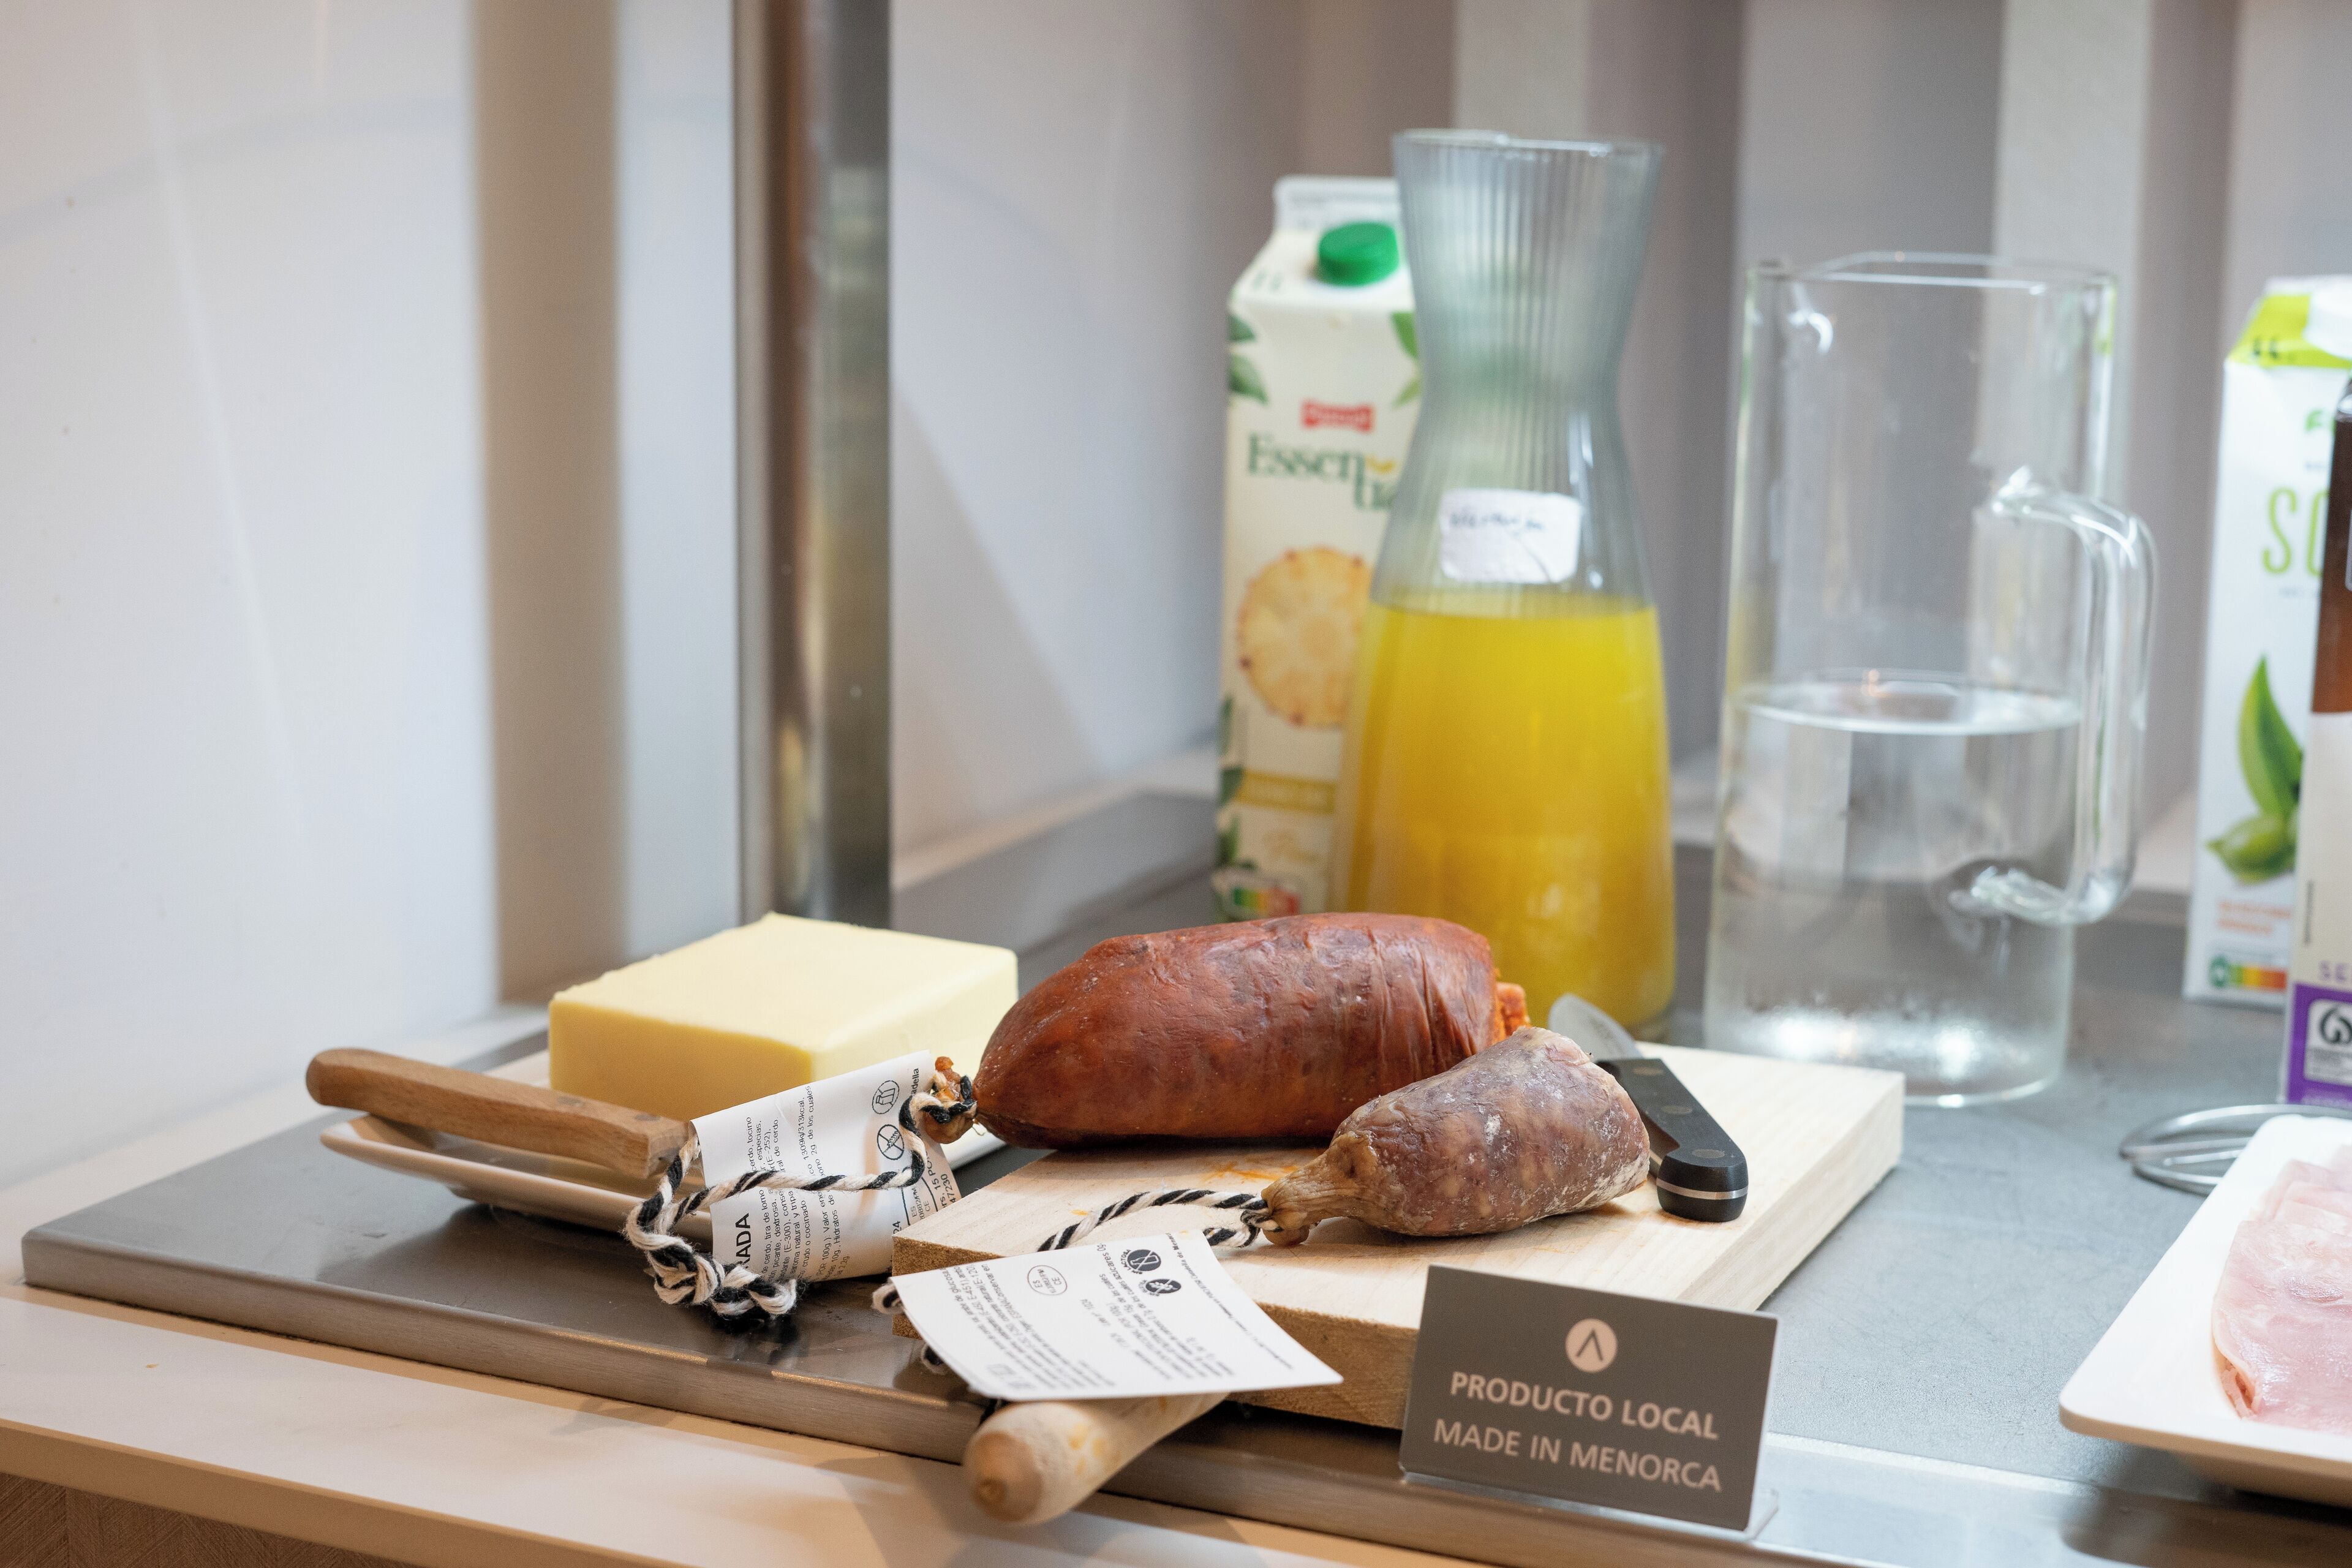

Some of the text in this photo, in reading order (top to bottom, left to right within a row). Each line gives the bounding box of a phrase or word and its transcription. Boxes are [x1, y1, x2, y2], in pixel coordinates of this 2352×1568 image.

[805, 1085, 813, 1112] cuales
[807, 1129, 813, 1139] de
[774, 1145, 780, 1156] de
[931, 1177, 940, 1190] 15
[758, 1189, 767, 1210] lomo
[788, 1190, 797, 1210] tripa
[827, 1194, 834, 1205] de
[910, 1205, 917, 1217] ES
[922, 1200, 930, 1212] CE
[763, 1212, 770, 1223] de
[763, 1240, 772, 1264] cerdo,
[979, 1263, 990, 1272] en
[1099, 1251, 1122, 1281] azúcares
[1031, 1279, 1043, 1288] ES
[1050, 1276, 1062, 1285] CE
[1451, 1371, 1719, 1440] PRODUCTO LOCAL
[1433, 1419, 1722, 1492] MADE IN MENORCA
